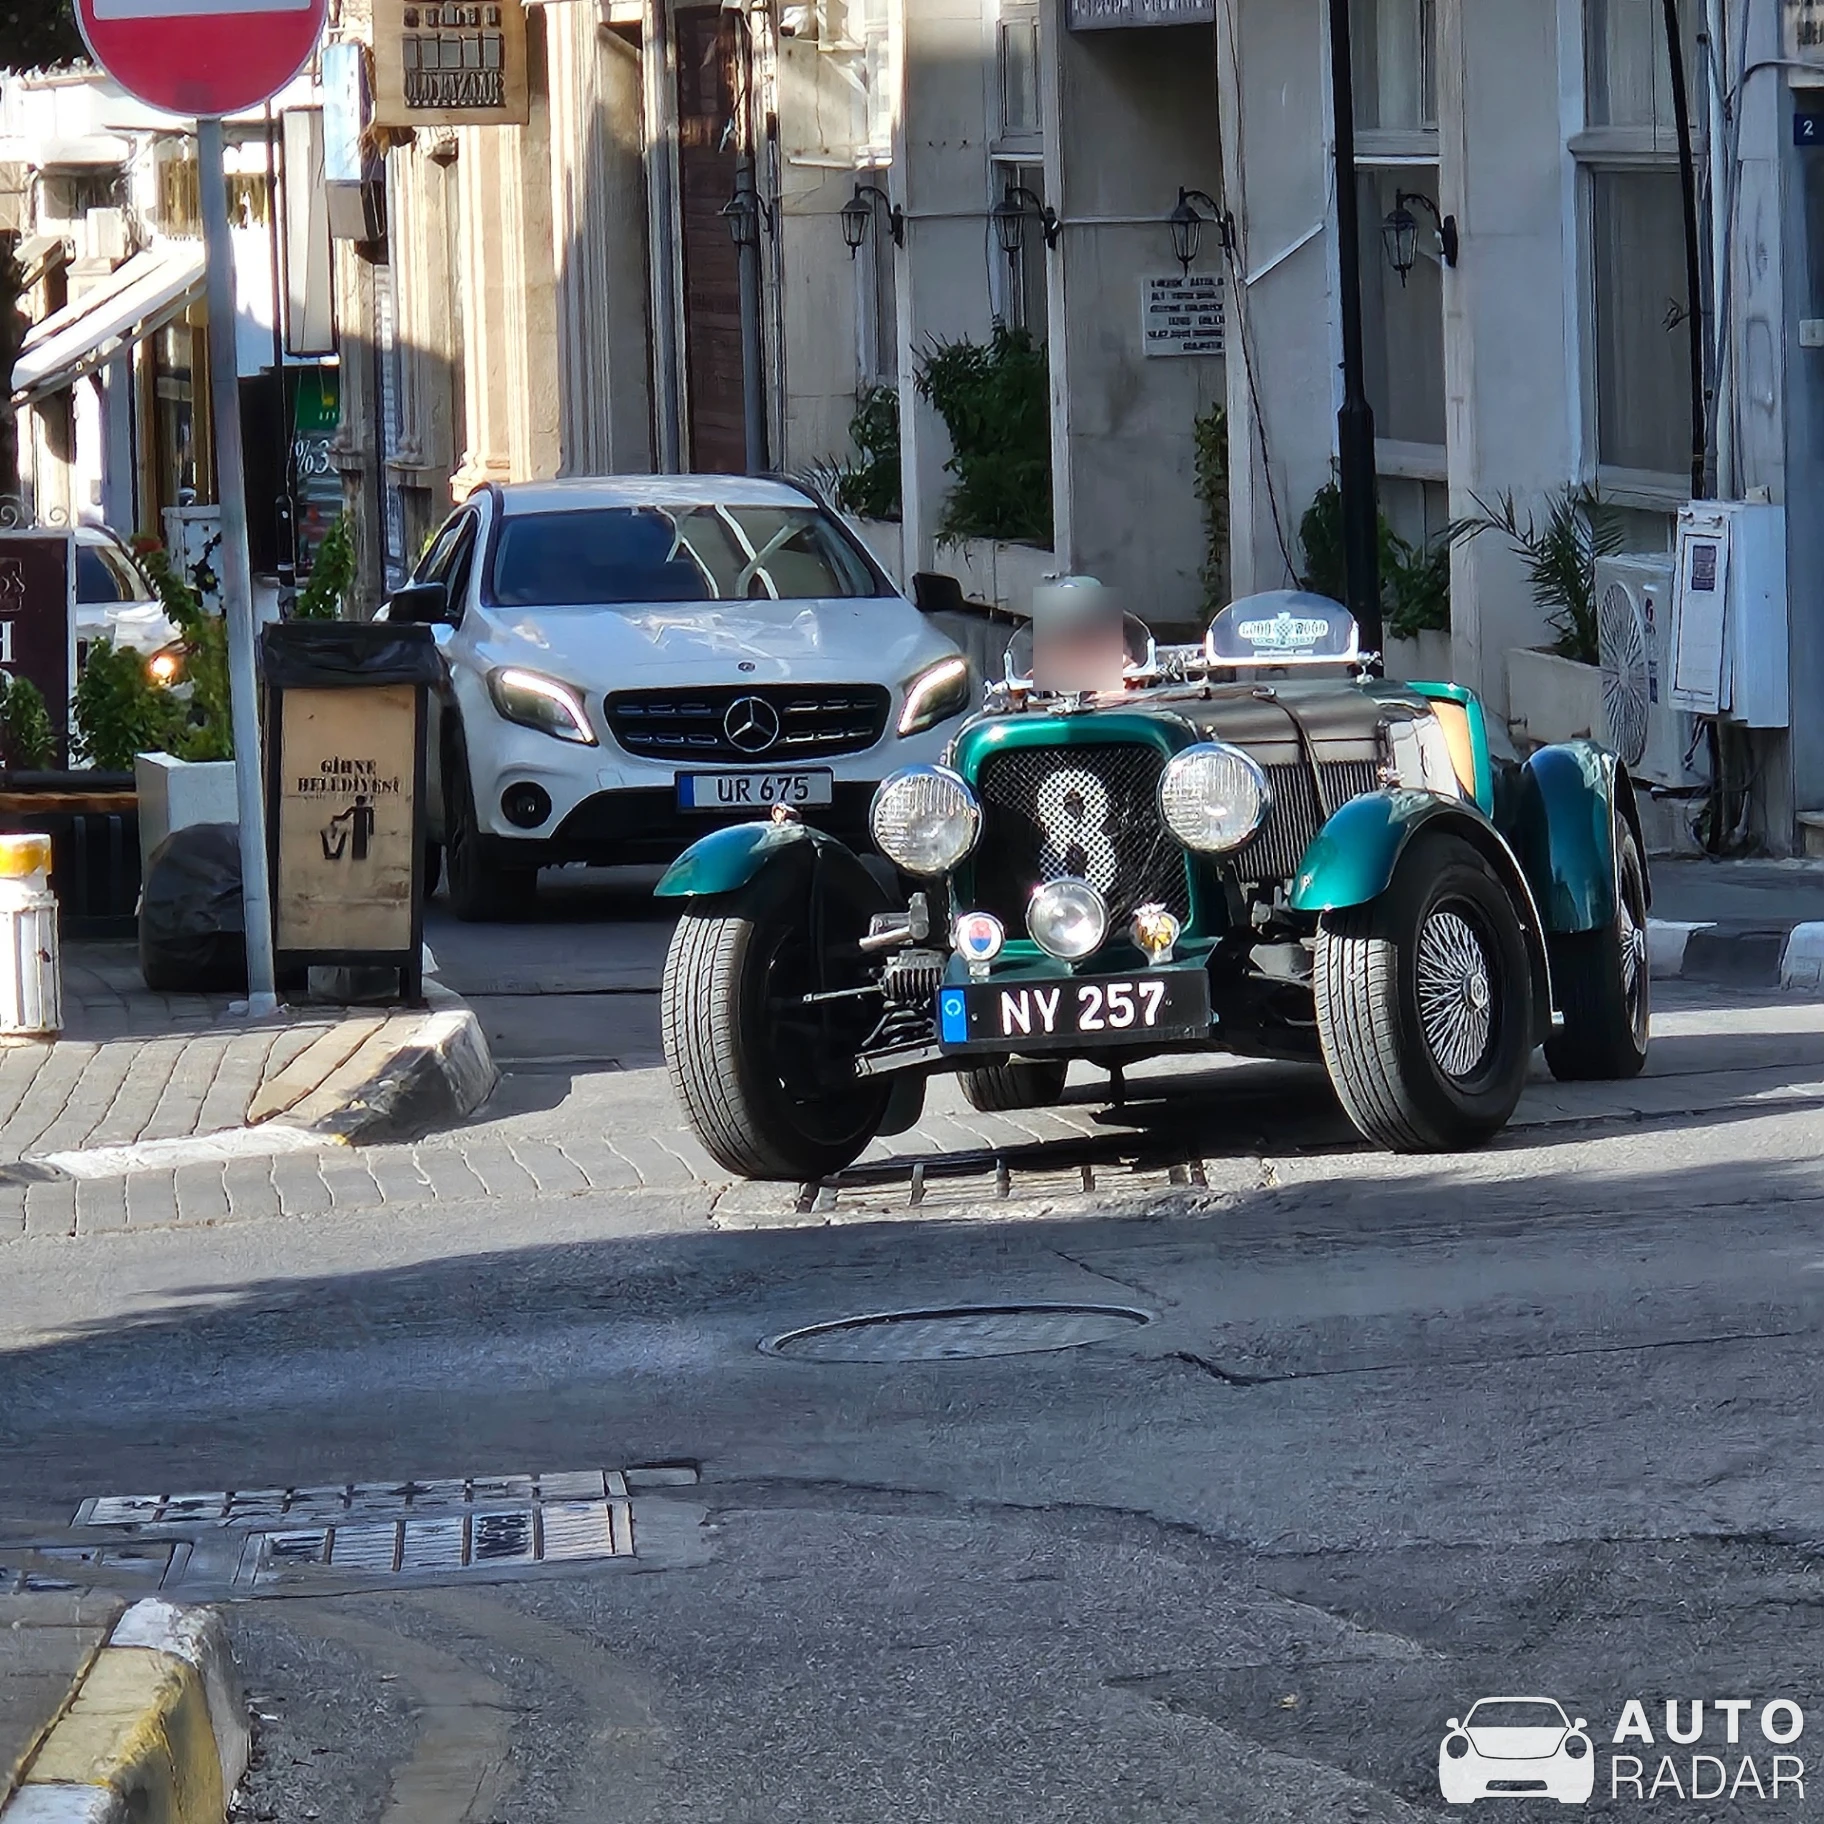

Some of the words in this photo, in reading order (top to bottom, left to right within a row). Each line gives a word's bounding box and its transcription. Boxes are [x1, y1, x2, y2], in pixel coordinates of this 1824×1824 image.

[1803, 120, 1814, 136] 2
[717, 778, 752, 802] UR
[760, 776, 809, 801] 675
[1037, 769, 1118, 895] 8
[1001, 988, 1060, 1036] NY
[1078, 981, 1165, 1031] 257
